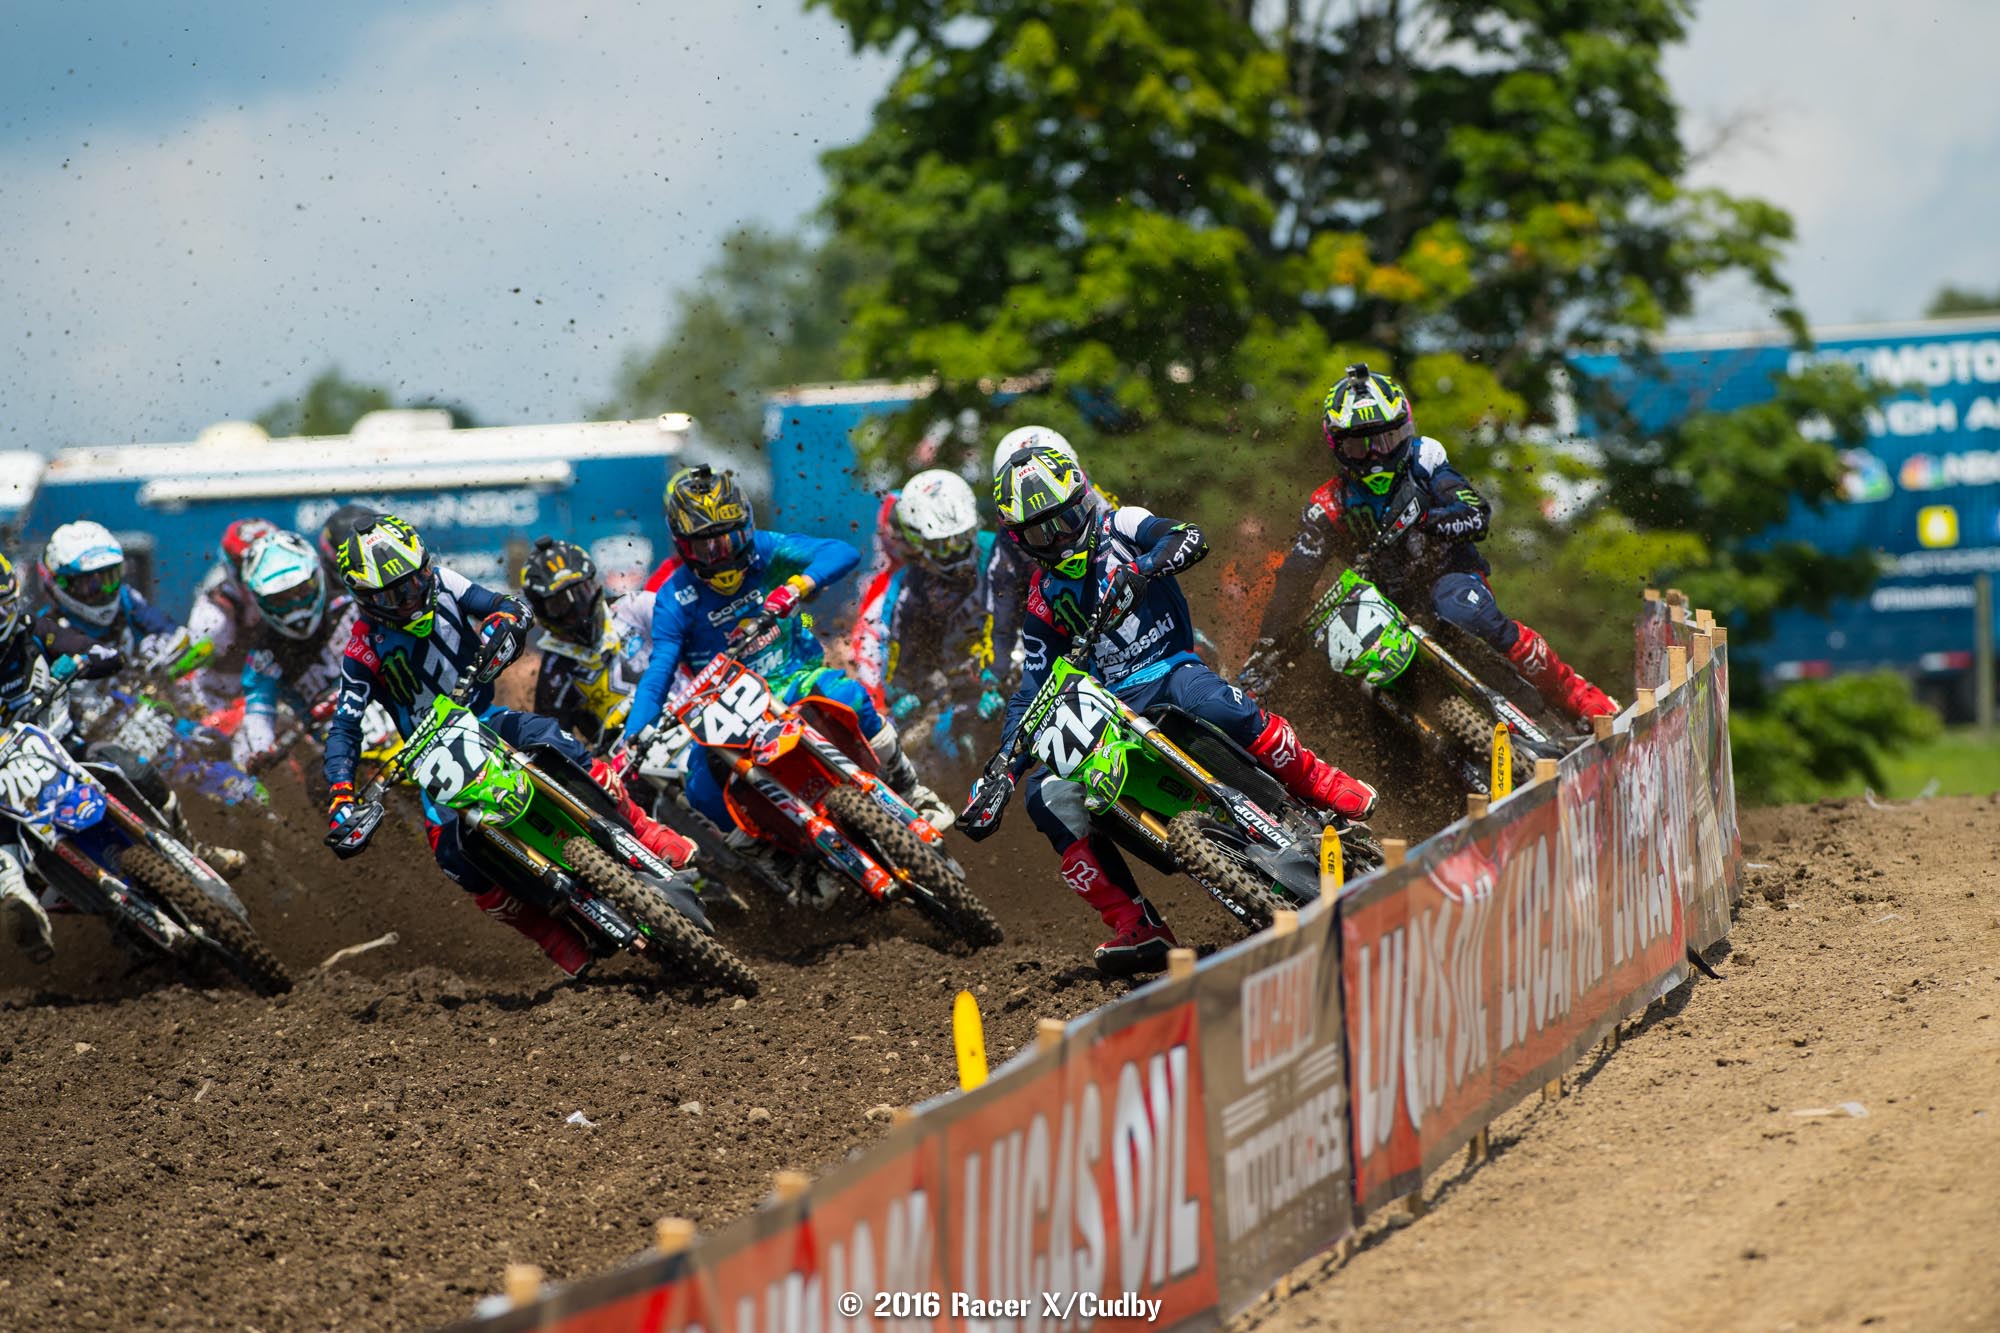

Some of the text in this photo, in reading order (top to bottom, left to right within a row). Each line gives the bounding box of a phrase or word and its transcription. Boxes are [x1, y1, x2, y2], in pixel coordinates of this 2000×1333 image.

[1018, 466, 1037, 478] BELL
[366, 533, 383, 546] BELL
[707, 588, 761, 622] GoPro
[671, 656, 726, 711] RENTHAL
[703, 673, 770, 745] 42
[1038, 677, 1118, 779] 214
[1039, 708, 1056, 731] LUCAS
[418, 711, 487, 804] 37
[420, 733, 440, 759] LUCAS
[1497, 745, 1505, 791] ACERBIS
[1112, 803, 1163, 844] PRO CIRCUIT
[1234, 804, 1292, 850] DUNLOP
[486, 829, 539, 870] PRO CIRCUIT
[615, 834, 675, 880] DUNLOP
[1191, 873, 1246, 918] UNLOP
[1358, 896, 1451, 1161] LUCAS
[1450, 873, 1494, 1091] OIL
[962, 1082, 1101, 1333] LUCAS
[1113, 1044, 1200, 1300] OIL
